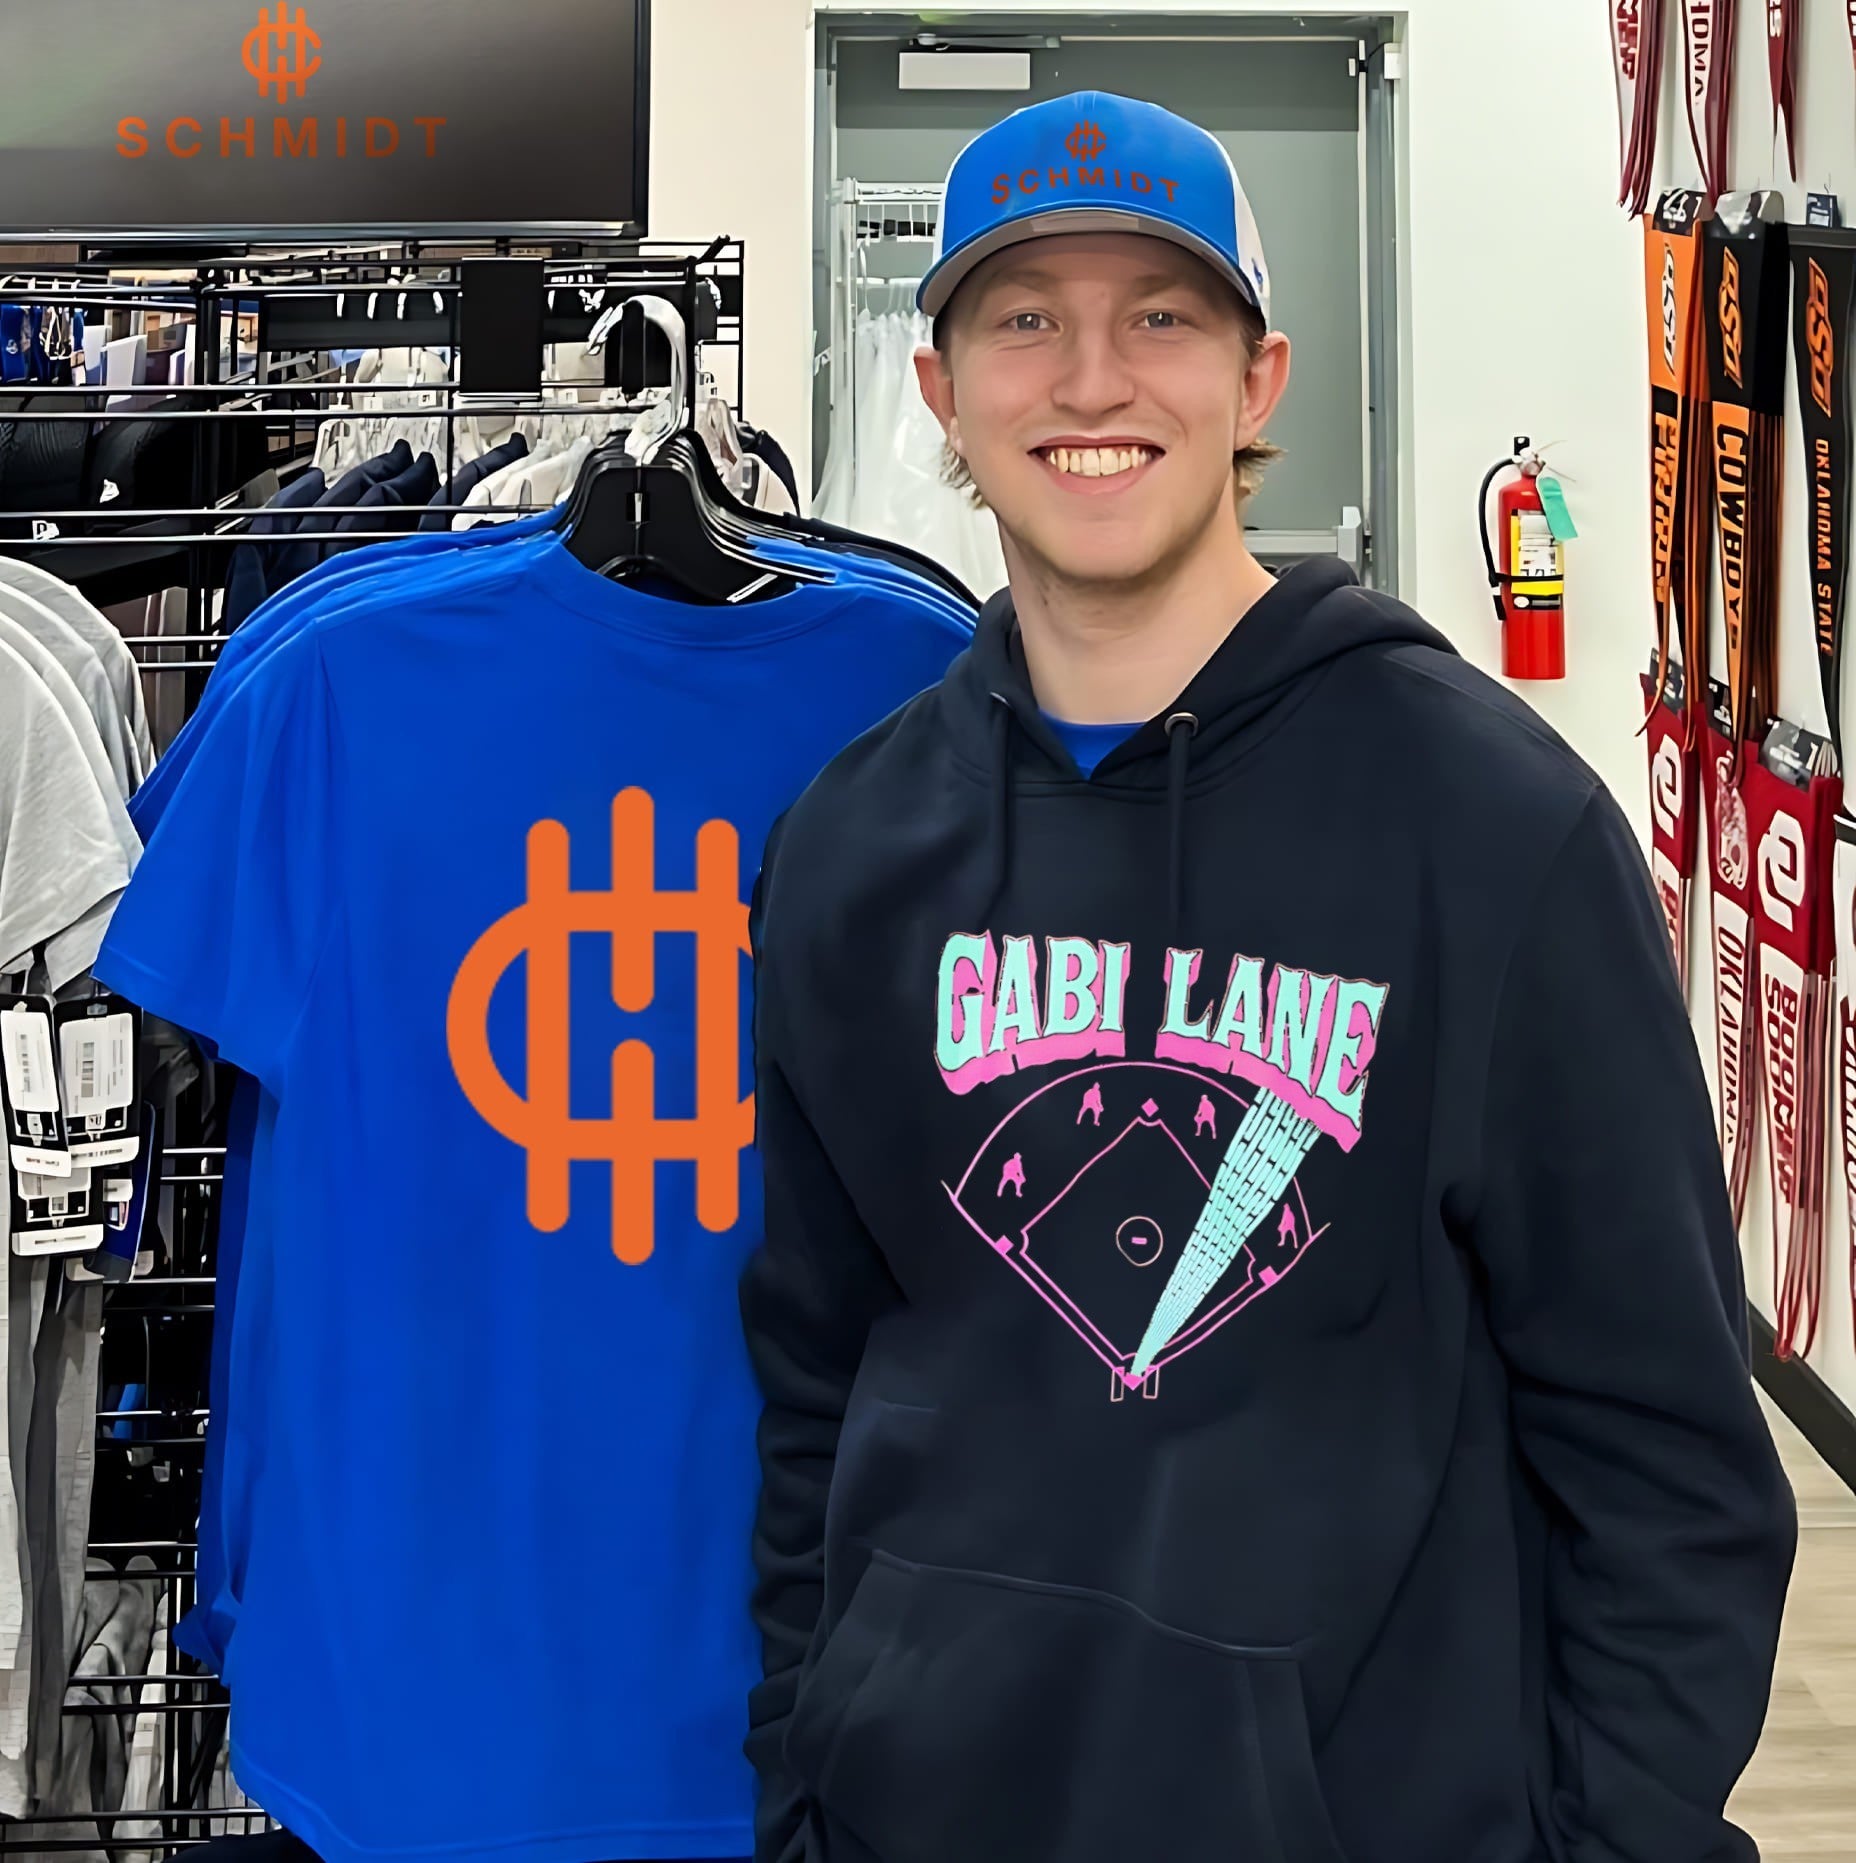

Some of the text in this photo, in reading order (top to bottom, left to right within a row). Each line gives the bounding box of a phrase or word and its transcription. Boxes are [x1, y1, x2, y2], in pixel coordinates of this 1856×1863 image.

[116, 117, 447, 158] SCHMIDT
[992, 166, 1179, 205] SCHMIDT
[1815, 438, 1832, 570] OKLAHOMA
[934, 929, 1390, 1153] GABI LANE
[1718, 926, 1746, 1144] OKLAHOMA
